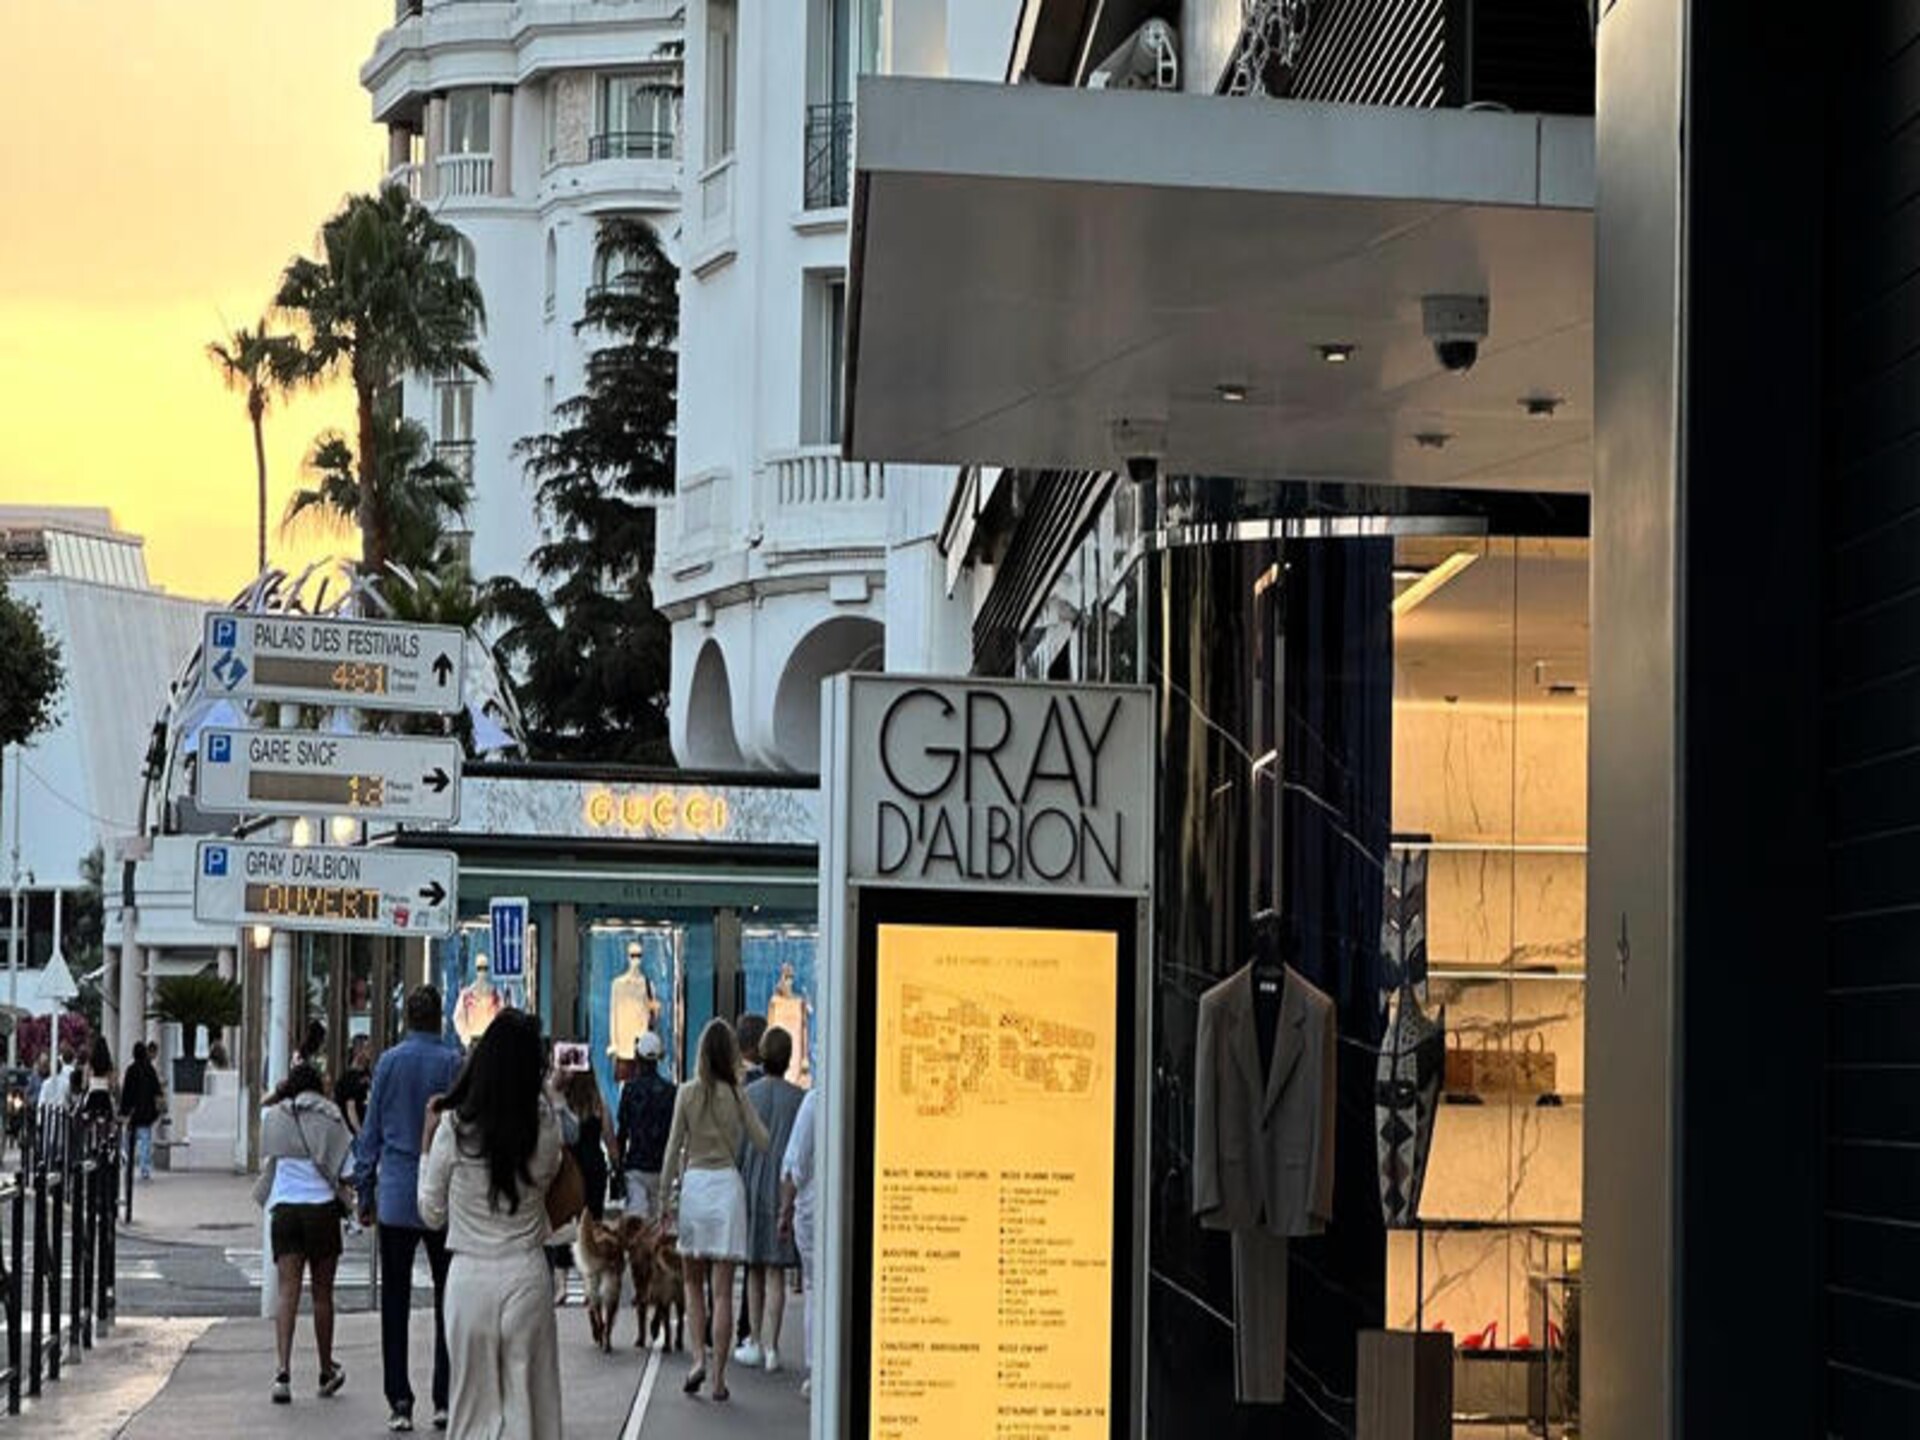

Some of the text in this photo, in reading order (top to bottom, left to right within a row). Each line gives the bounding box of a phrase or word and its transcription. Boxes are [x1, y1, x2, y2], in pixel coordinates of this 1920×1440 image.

[254, 623, 420, 658] PALAIS DES FESTIVALS
[250, 738, 337, 766] GARE SNCF
[879, 688, 1122, 808] GRAY
[589, 793, 726, 828] GUCCI
[877, 801, 1122, 884] D'ALBION
[246, 852, 361, 880] GRAY D'ALBION
[265, 884, 380, 919] OUVERT
